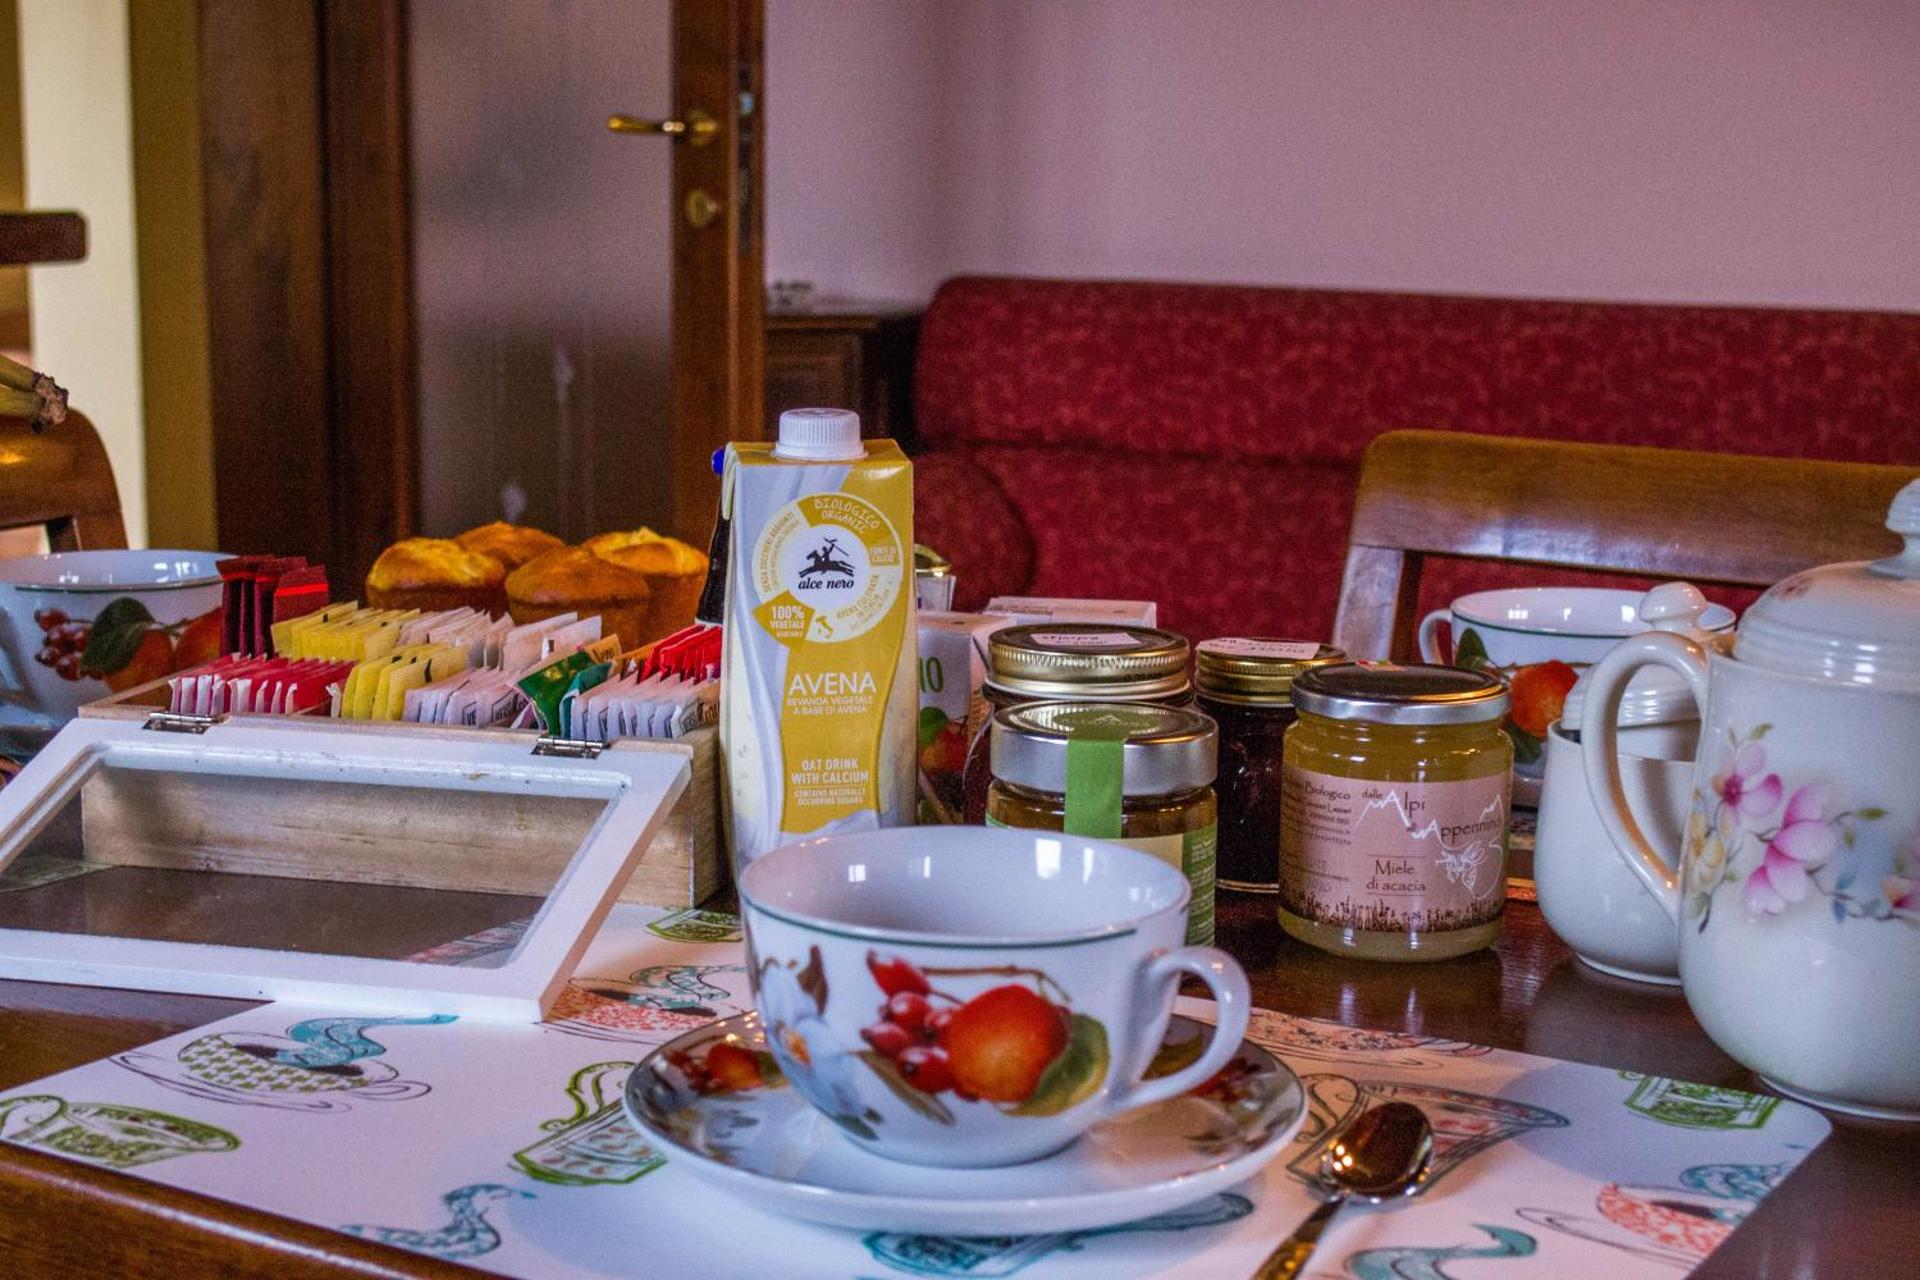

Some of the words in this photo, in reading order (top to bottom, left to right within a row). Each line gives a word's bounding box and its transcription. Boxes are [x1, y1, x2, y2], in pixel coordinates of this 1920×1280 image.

[814, 498, 880, 529] BIOLOGICO
[798, 577, 823, 589] alce
[826, 578, 855, 589] nero
[771, 605, 804, 619] 100%
[789, 672, 876, 695] AVENA
[802, 759, 821, 770] OAT
[825, 757, 858, 770] DRINK
[791, 771, 819, 784] WITH
[822, 769, 869, 784] CALCIUM
[1362, 788, 1383, 799] dalle
[1375, 860, 1415, 875] Miele
[1366, 876, 1378, 890] di
[1382, 882, 1426, 891] acacia
